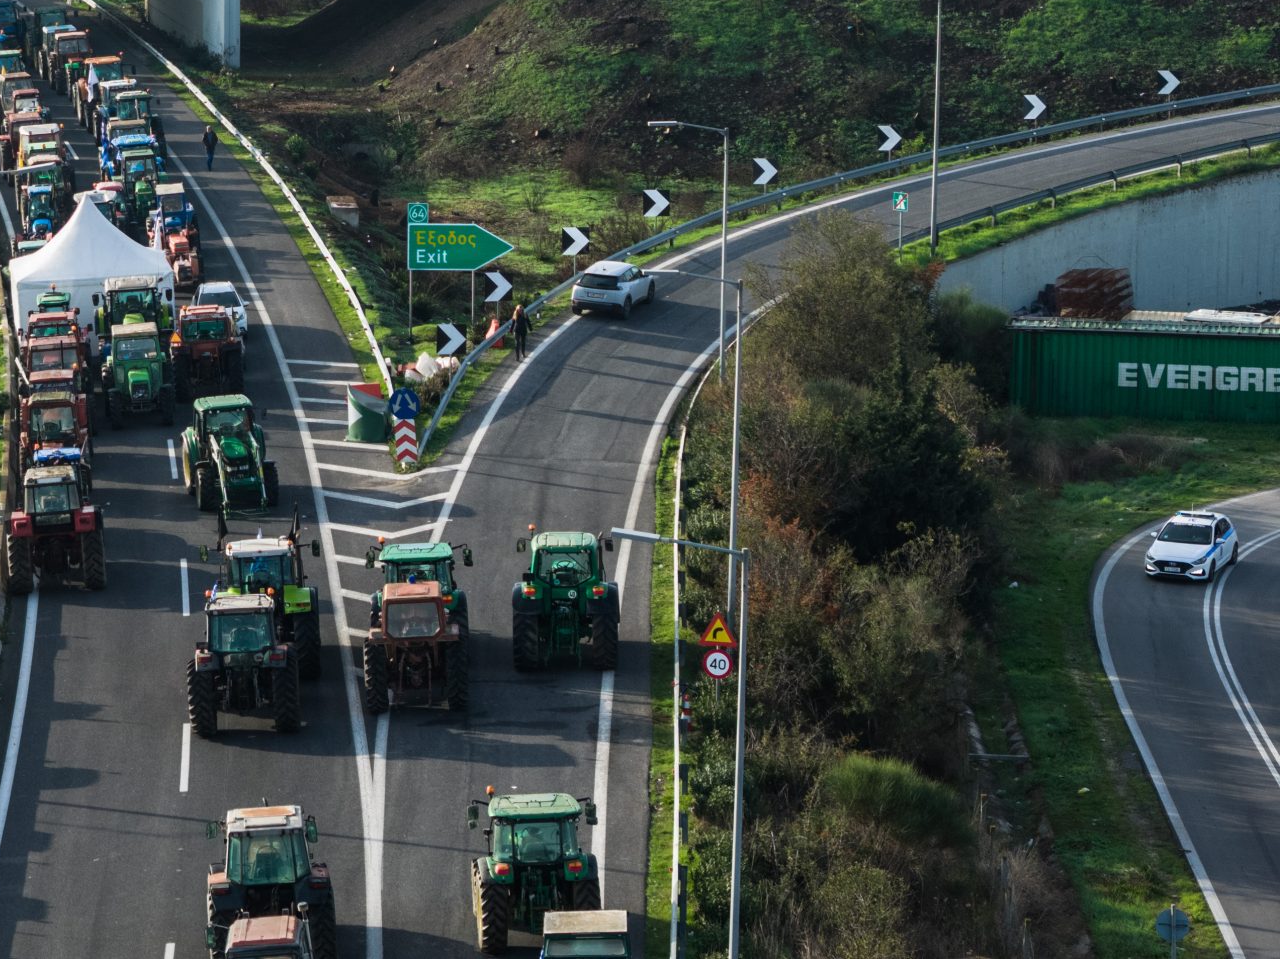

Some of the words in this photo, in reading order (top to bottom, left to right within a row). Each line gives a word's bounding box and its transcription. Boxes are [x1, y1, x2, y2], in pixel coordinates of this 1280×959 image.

[411, 209, 424, 218] 64
[415, 230, 477, 248] Έξοδος
[416, 249, 448, 263] Exit
[1117, 362, 1280, 393] EVERGRE
[709, 658, 727, 670] 40
